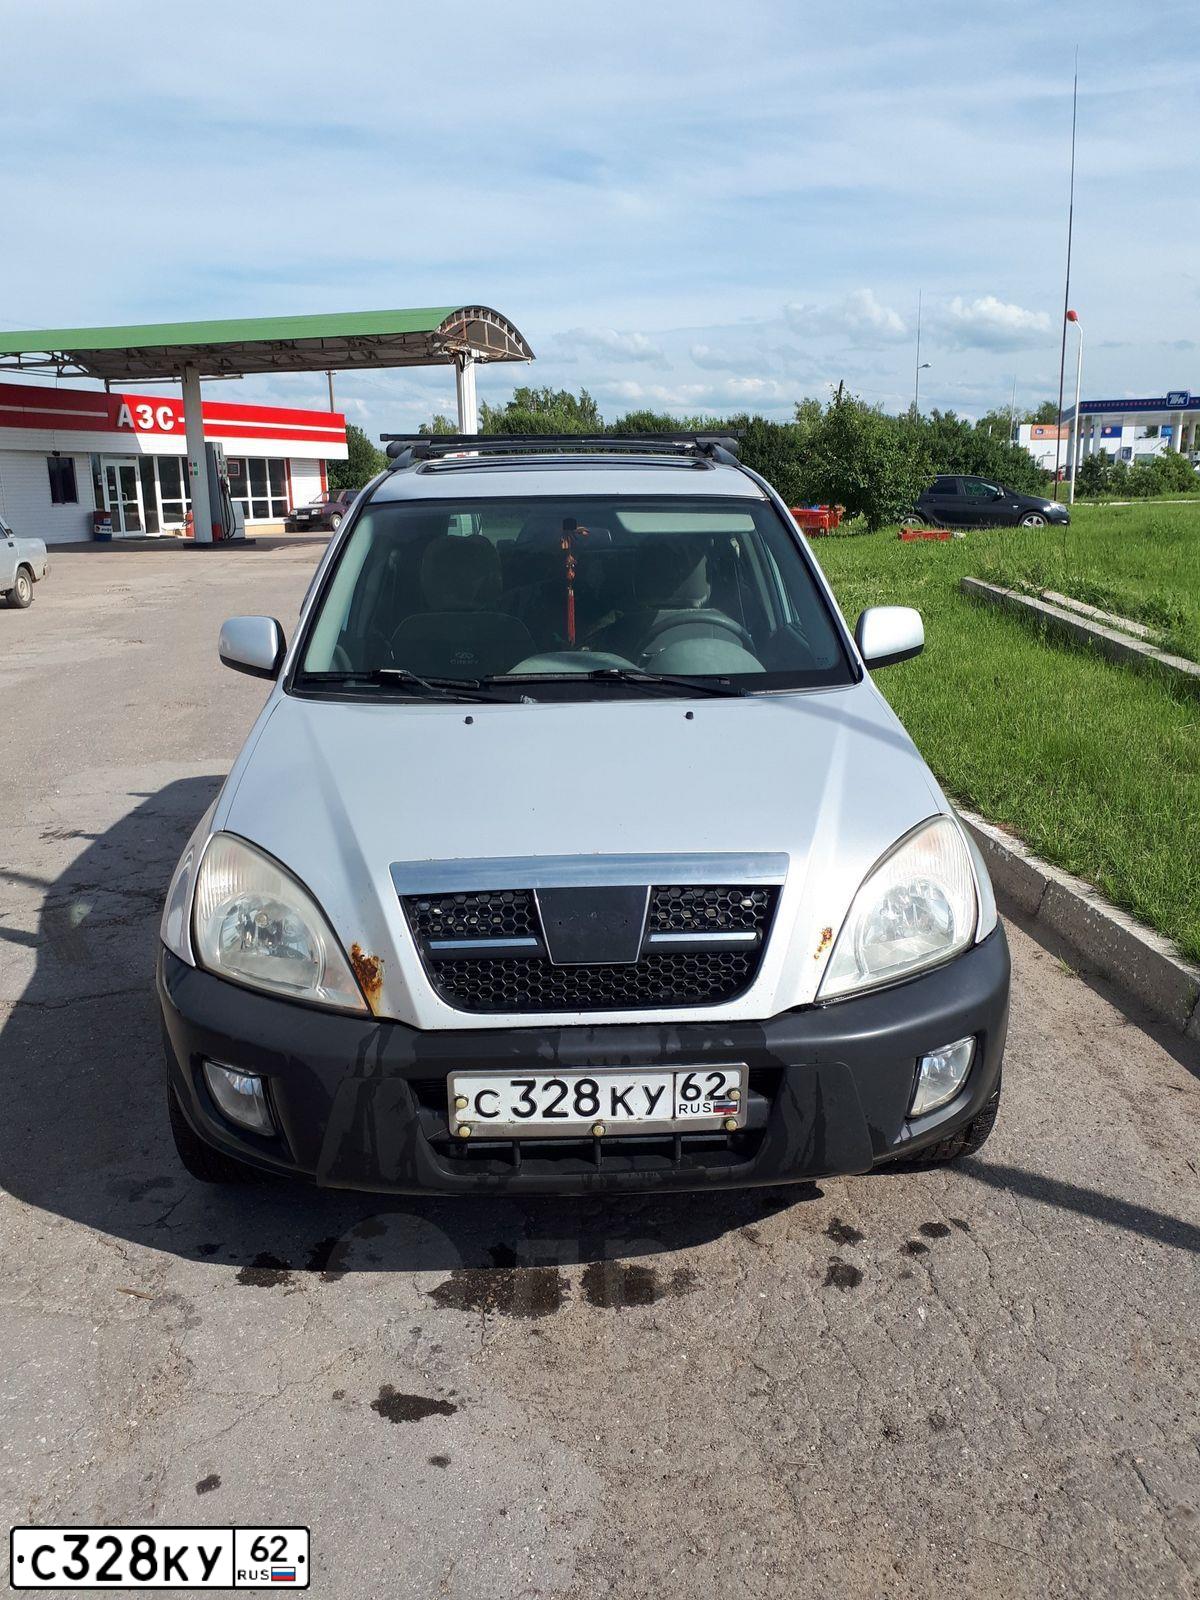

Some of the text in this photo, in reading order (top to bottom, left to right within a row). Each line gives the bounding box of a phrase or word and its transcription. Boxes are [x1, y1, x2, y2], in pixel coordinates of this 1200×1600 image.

[117, 403, 175, 431] АЗС
[473, 1076, 666, 1119] С328КУ
[680, 1071, 727, 1101] 62
[678, 1100, 712, 1115] RUS
